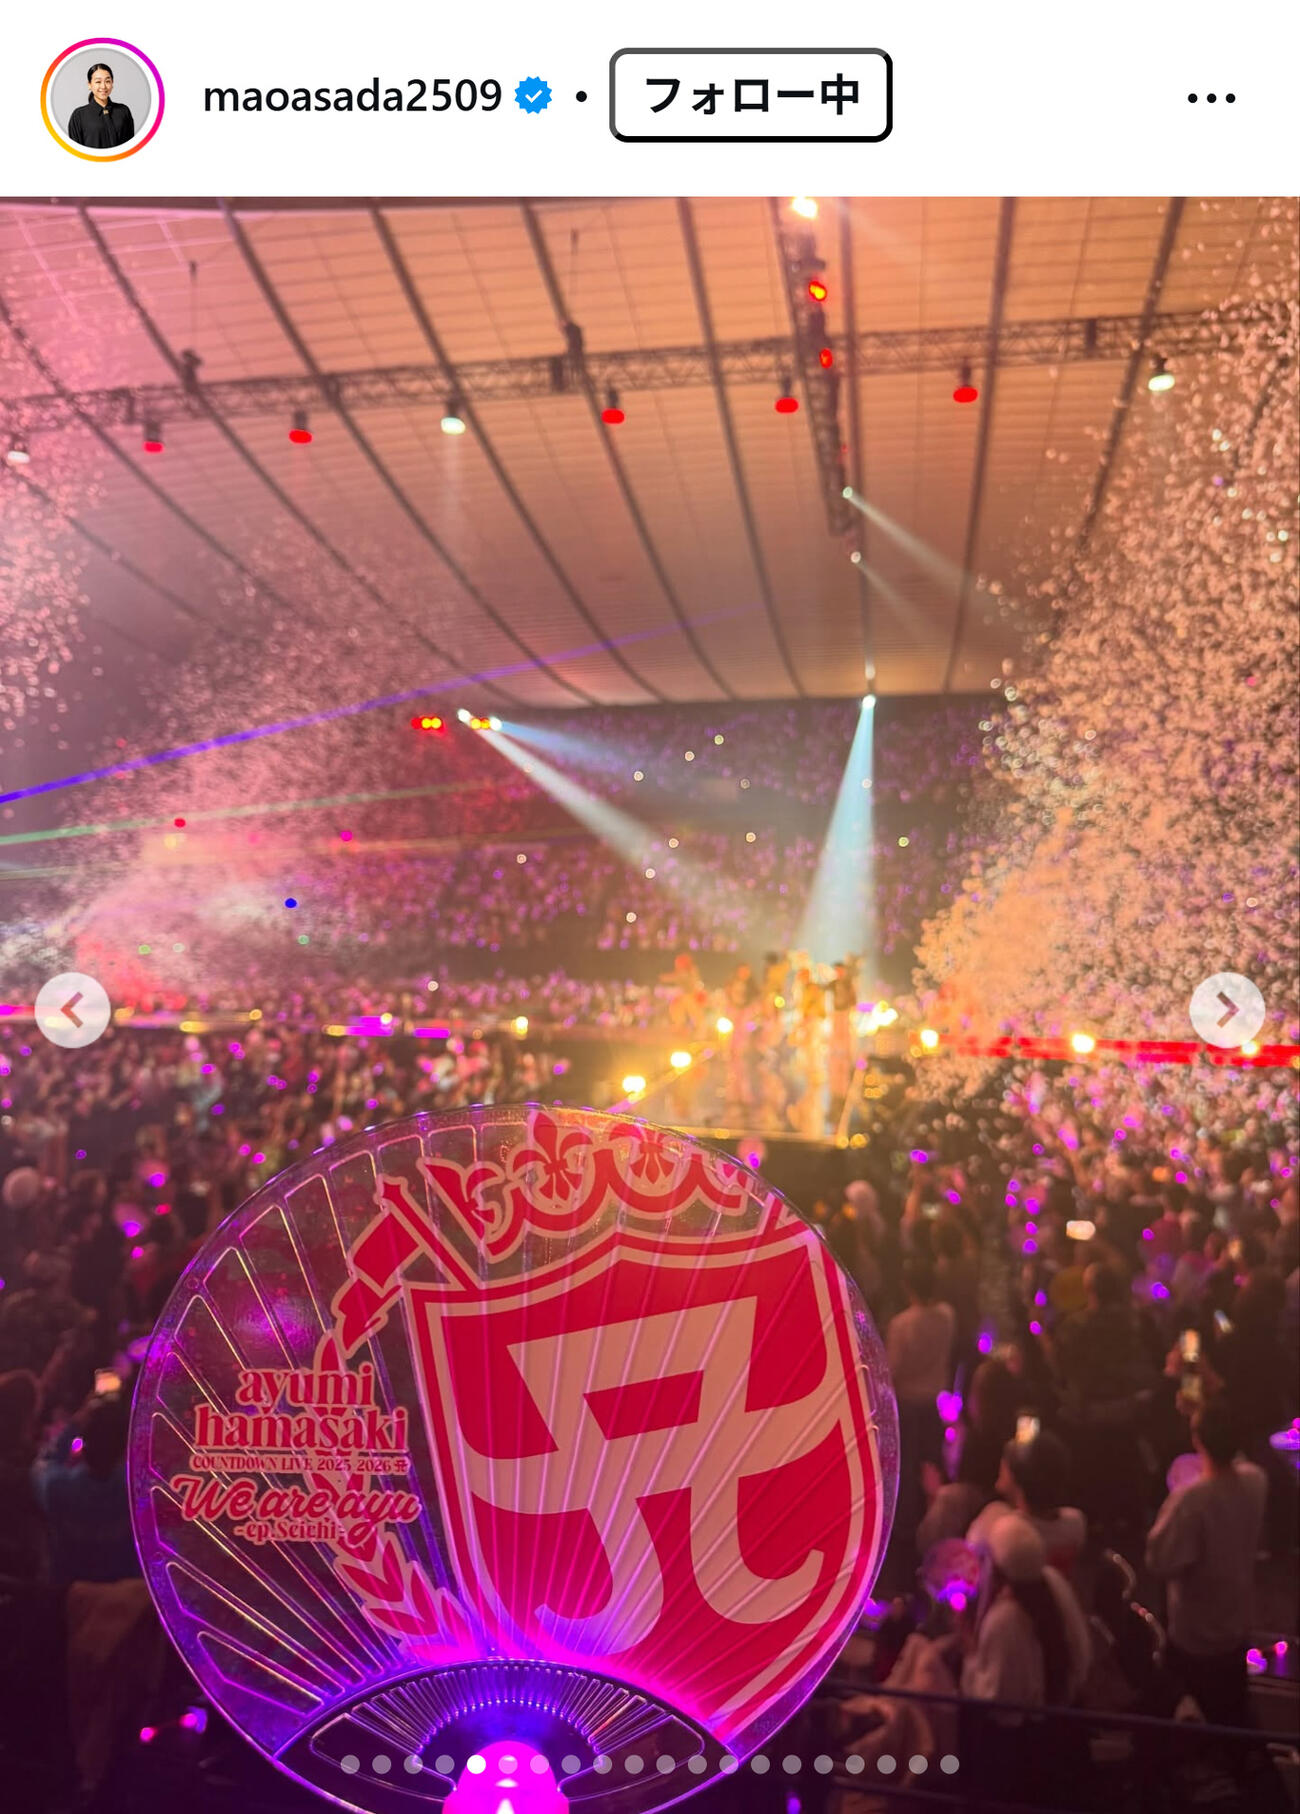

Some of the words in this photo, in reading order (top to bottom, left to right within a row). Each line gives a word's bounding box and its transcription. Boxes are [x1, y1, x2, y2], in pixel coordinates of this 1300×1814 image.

[240, 1364, 373, 1414] ayumi
[197, 1407, 406, 1450] hamasaki
[193, 1456, 277, 1470] COUNTDOWN
[281, 1457, 313, 1471] LIVE
[172, 1478, 255, 1518] We
[258, 1490, 334, 1519] are
[337, 1491, 418, 1541] ayu
